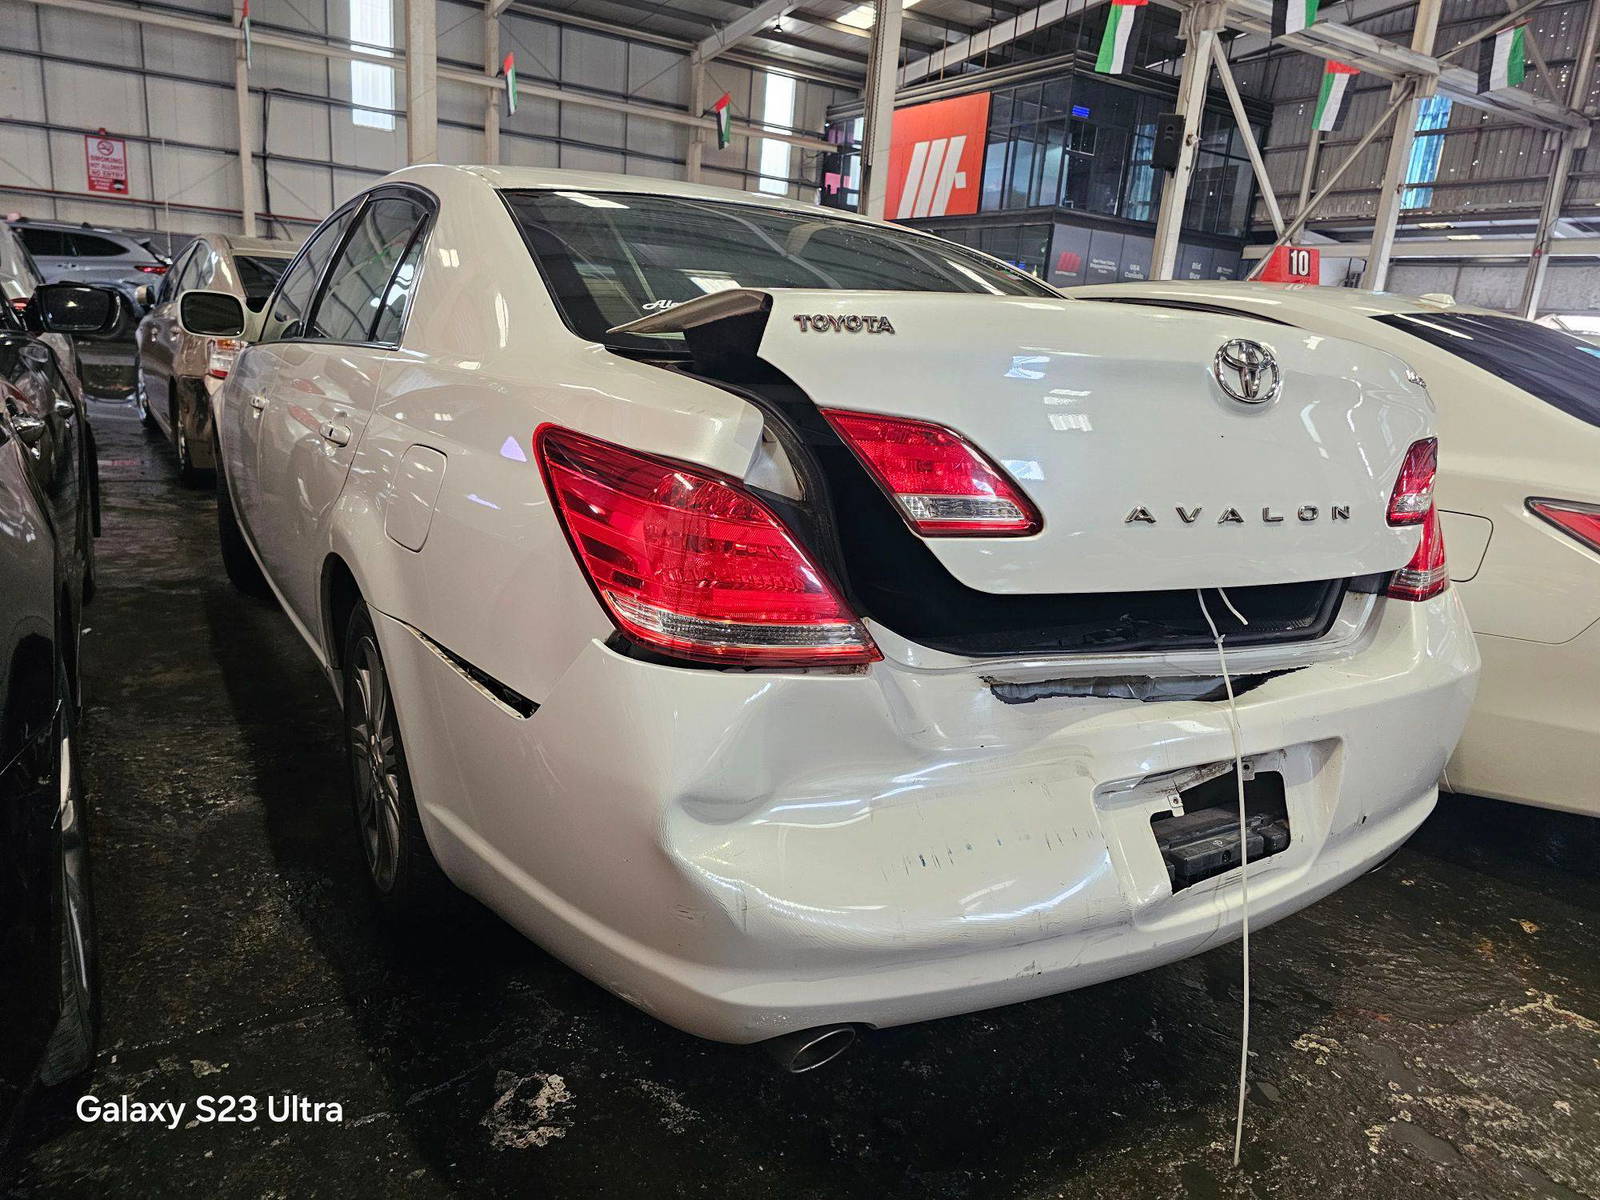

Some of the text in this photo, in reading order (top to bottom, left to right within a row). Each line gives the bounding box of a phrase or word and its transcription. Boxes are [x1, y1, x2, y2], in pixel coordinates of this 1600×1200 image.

[1291, 250, 1309, 276] 10
[793, 314, 896, 335] TOYOTA
[1125, 504, 1352, 525] AVALON
